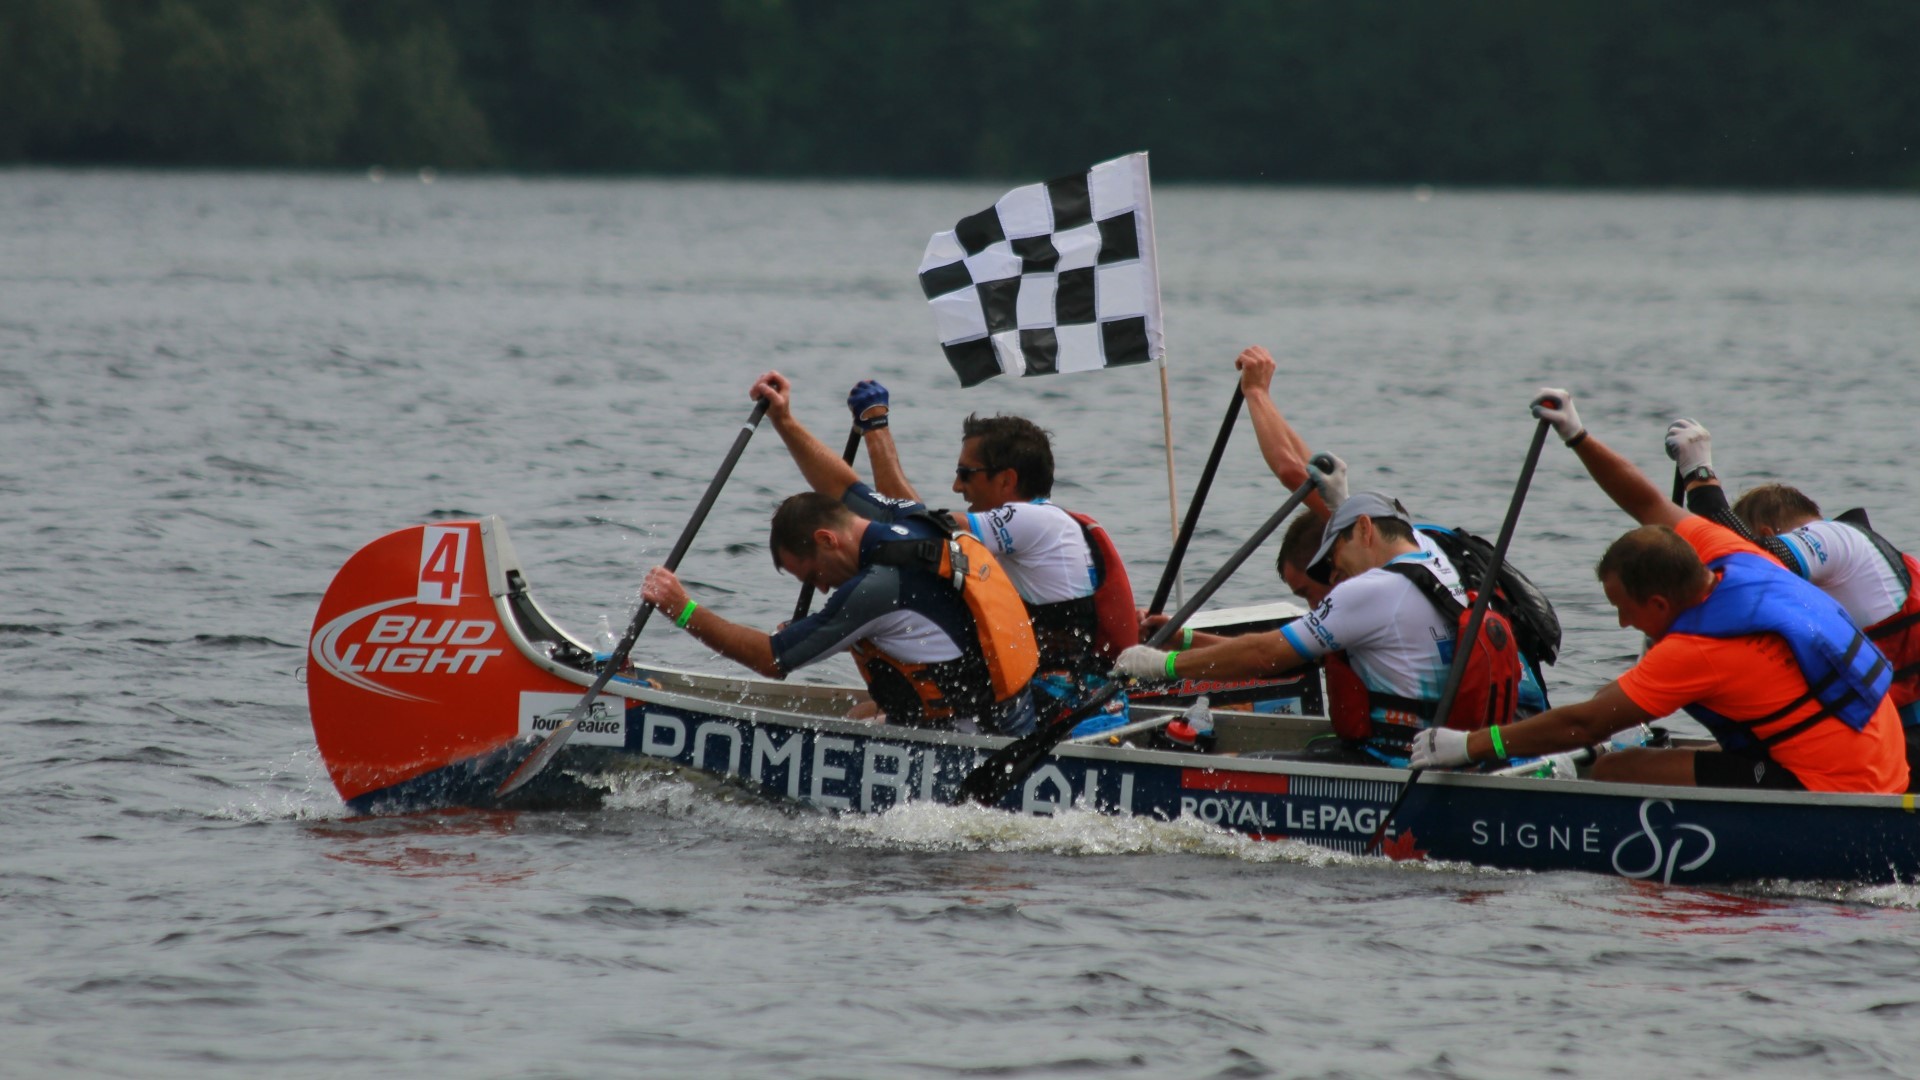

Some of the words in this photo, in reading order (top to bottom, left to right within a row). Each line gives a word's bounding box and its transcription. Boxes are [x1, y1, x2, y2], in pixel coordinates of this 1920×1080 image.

[420, 532, 461, 599] 4
[366, 615, 496, 645] BUD
[336, 643, 503, 674] LIGHT
[568, 720, 620, 734] eauce
[641, 712, 1135, 818] POMERLAU
[1181, 796, 1276, 828] ROYAL
[1472, 820, 1601, 853] SIGNÉ
